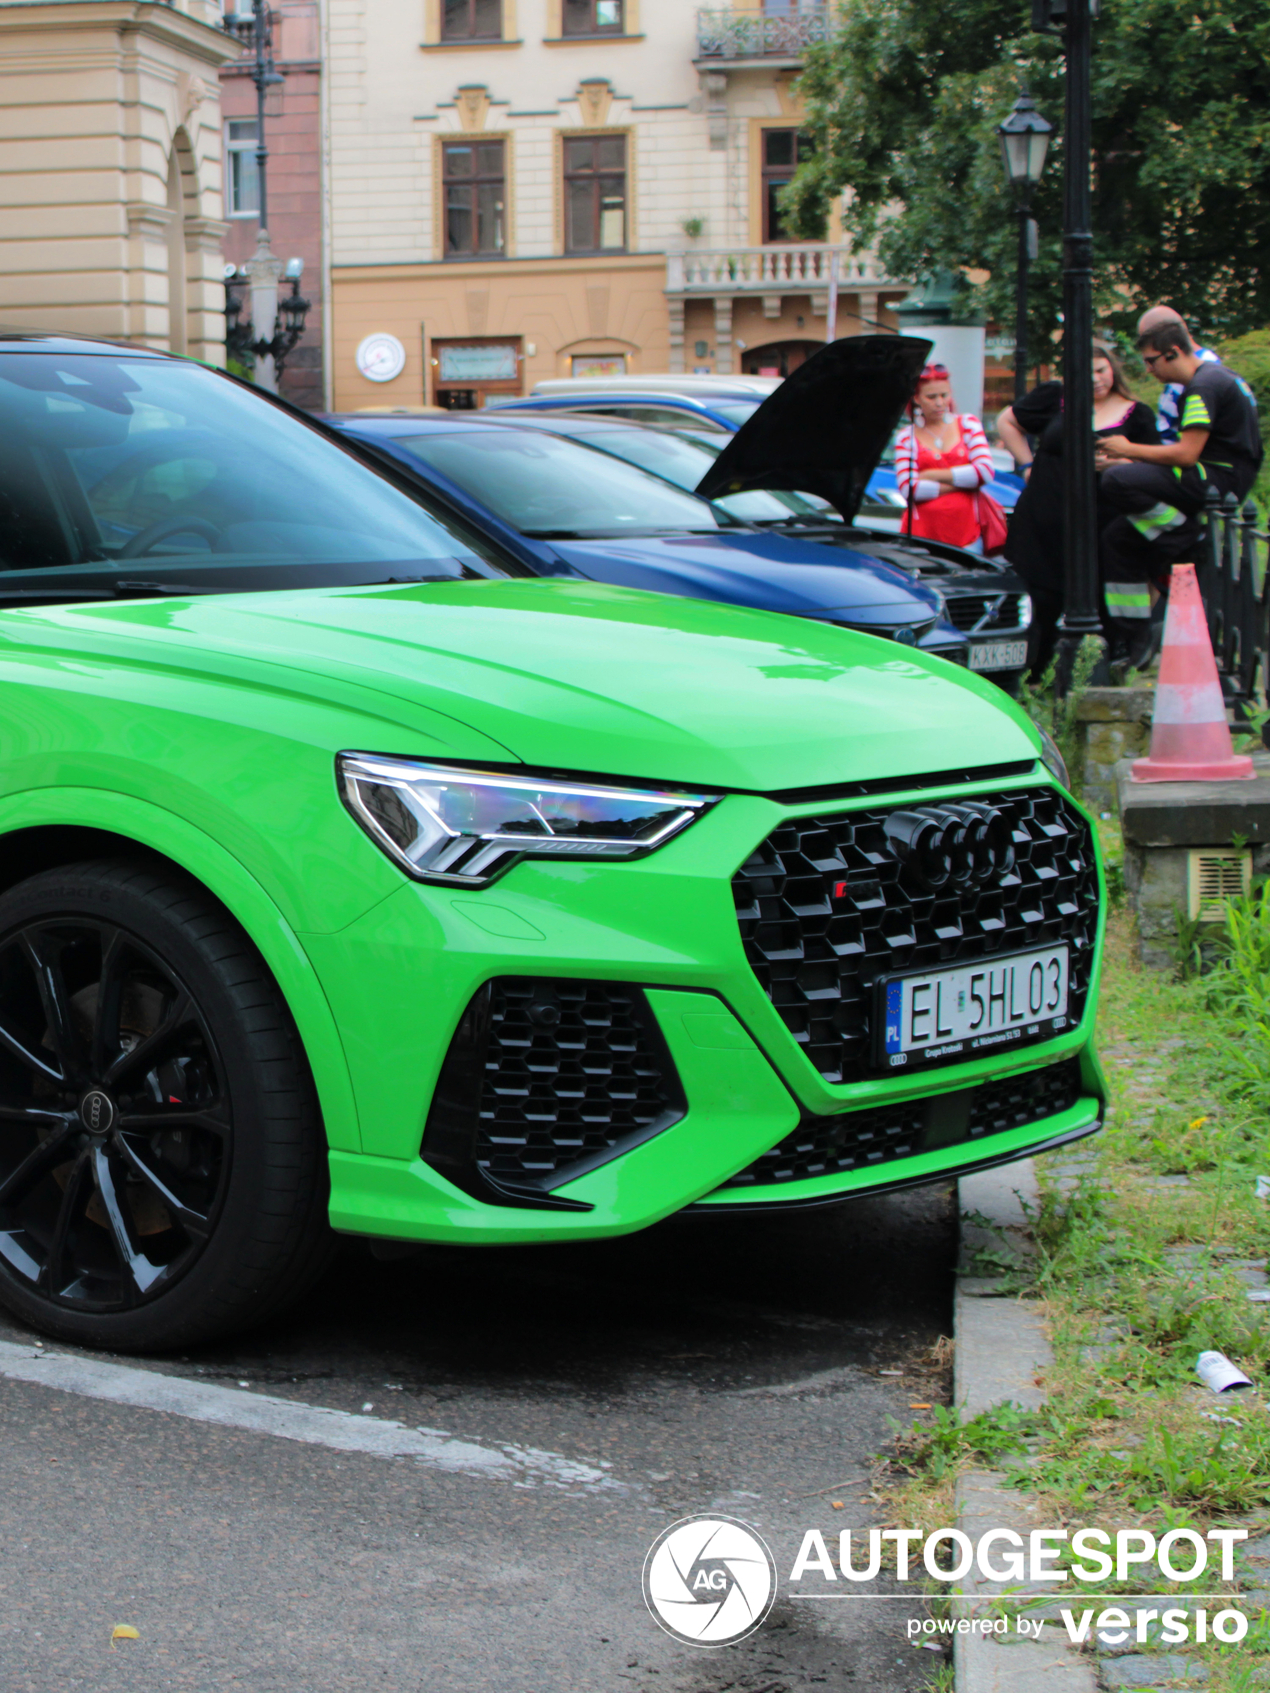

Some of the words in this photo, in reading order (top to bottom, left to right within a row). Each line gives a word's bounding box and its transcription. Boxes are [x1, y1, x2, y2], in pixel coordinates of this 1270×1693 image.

[911, 981, 953, 1043] EL
[970, 957, 1061, 1029] 5HL03
[887, 1026, 900, 1043] PL
